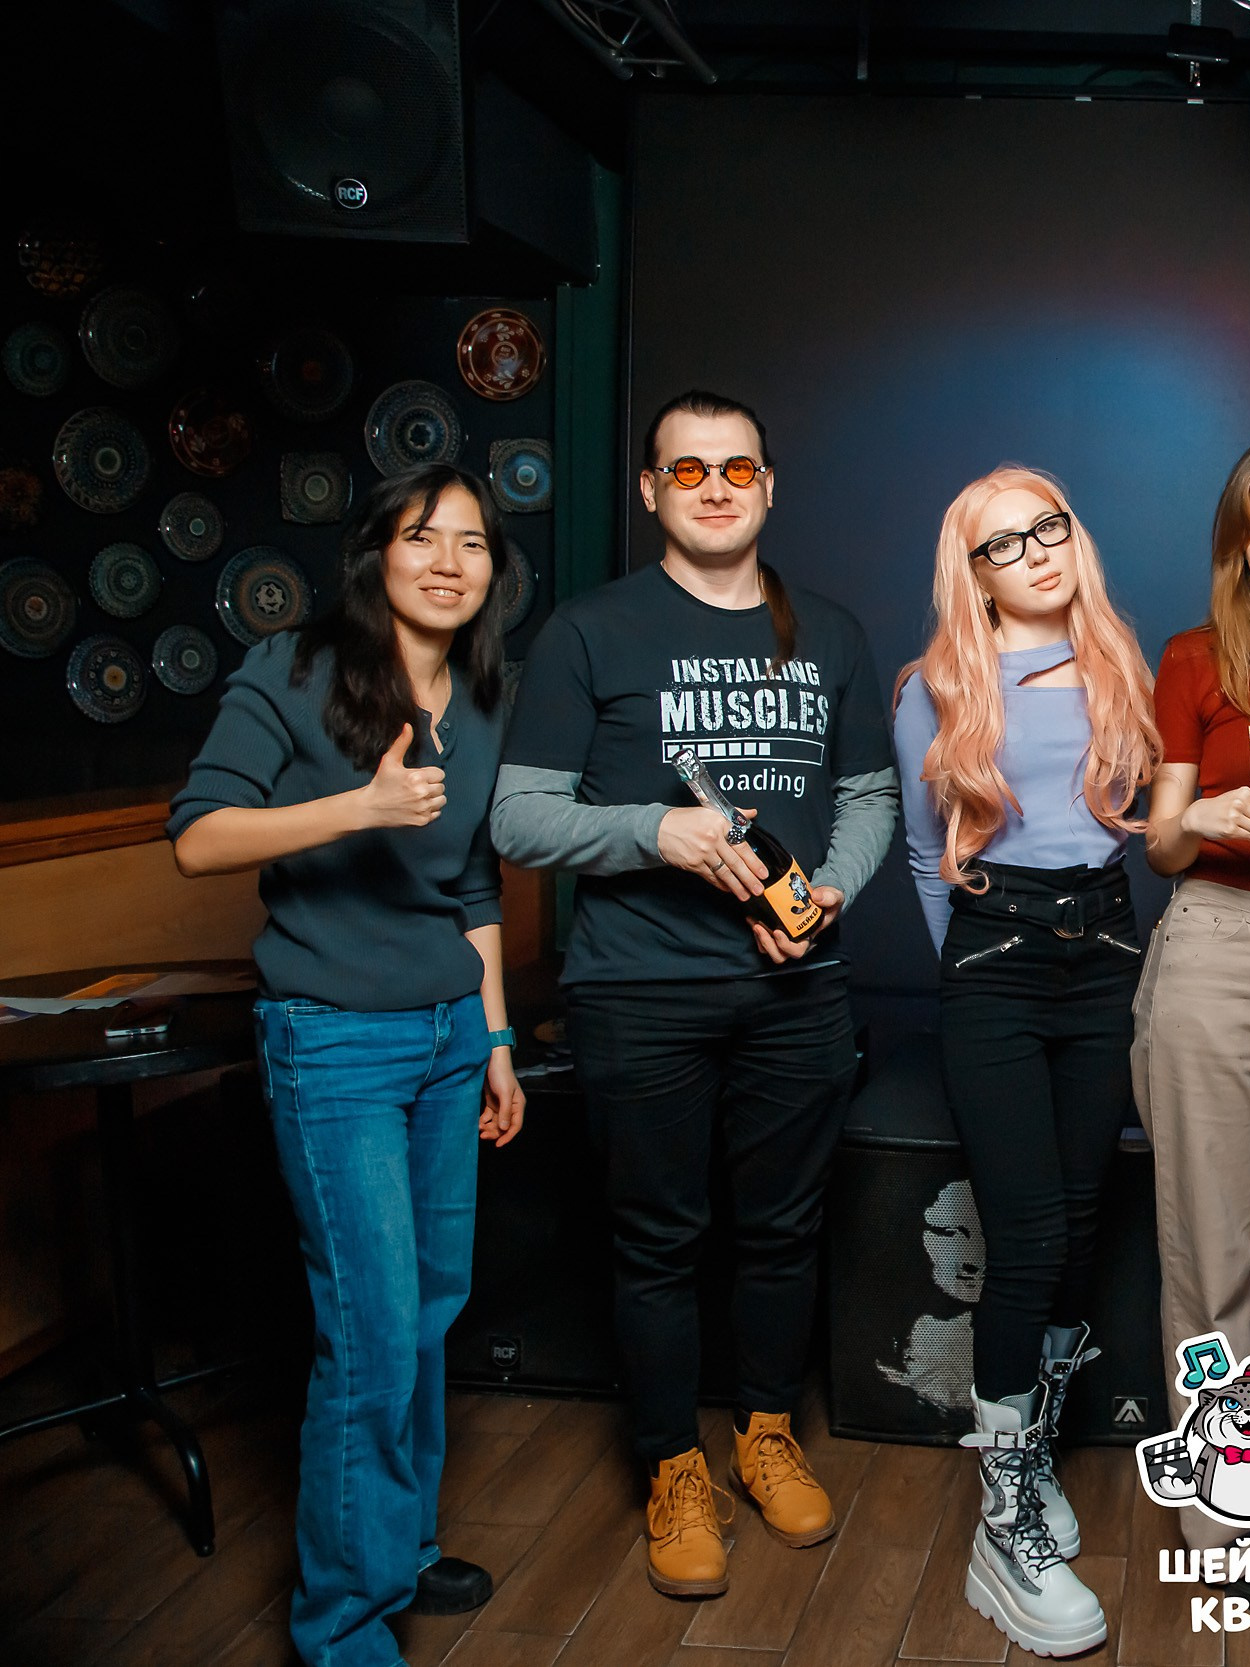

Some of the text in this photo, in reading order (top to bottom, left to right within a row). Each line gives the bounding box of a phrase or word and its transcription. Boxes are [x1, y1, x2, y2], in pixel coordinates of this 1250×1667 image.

[338, 187, 364, 200] RCF
[671, 656, 821, 687] INSTALLING
[660, 688, 829, 735] MUSCLES
[719, 768, 806, 798] oading
